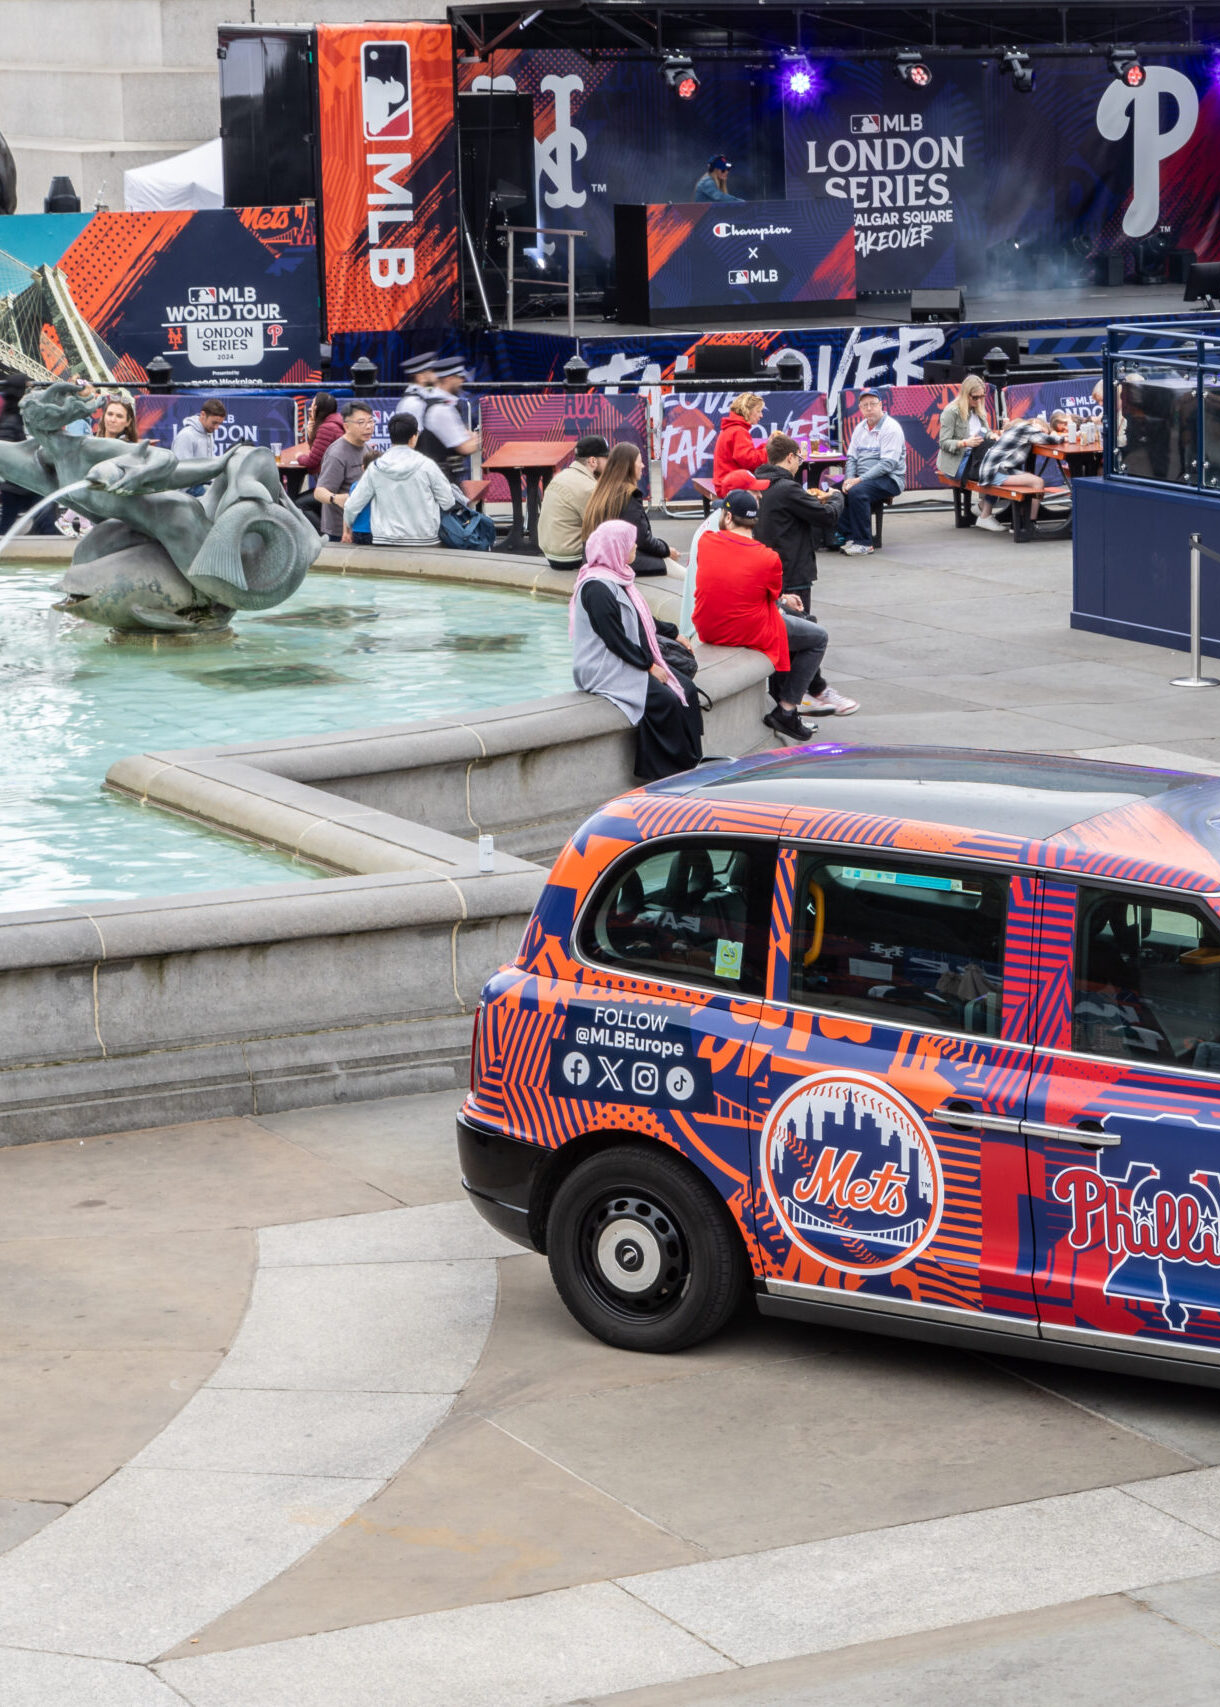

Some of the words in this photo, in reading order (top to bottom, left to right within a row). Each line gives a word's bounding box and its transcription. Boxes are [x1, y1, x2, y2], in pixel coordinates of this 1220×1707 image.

[883, 114, 923, 132] MLB
[806, 136, 965, 173] LONDON
[1097, 66, 1198, 237] P
[825, 173, 950, 208] SERIES
[239, 207, 289, 230] Mets
[366, 153, 415, 288] MLB
[902, 210, 953, 225] SQUARE
[713, 223, 792, 240] Champion
[750, 269, 778, 283] MLB
[218, 287, 257, 303] MLB
[166, 305, 232, 322] WORLD
[233, 304, 280, 320] TOUR
[197, 327, 253, 339] LONDON
[202, 340, 248, 351] SERIES
[173, 423, 258, 441] LDON
[661, 409, 829, 480] TAKOVER
[594, 1006, 669, 1032] FOLLOW
[576, 1027, 684, 1059] @MLBEurope
[793, 1146, 910, 1218] Mets
